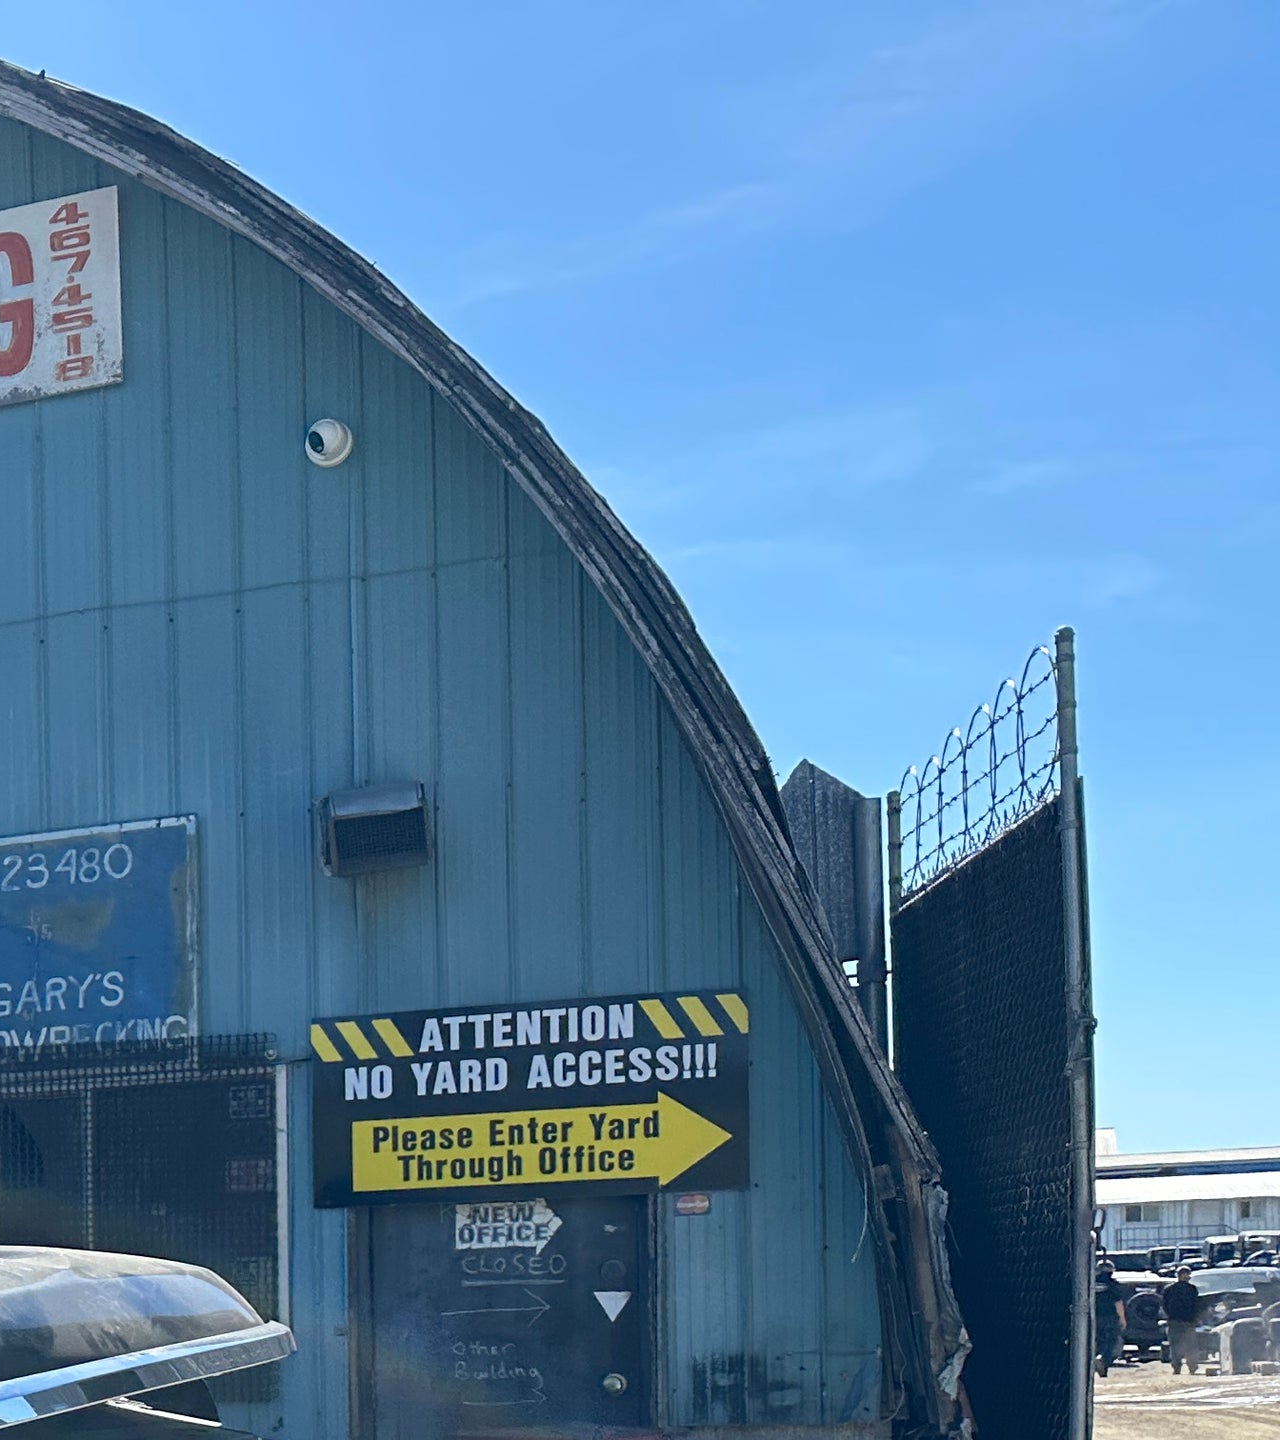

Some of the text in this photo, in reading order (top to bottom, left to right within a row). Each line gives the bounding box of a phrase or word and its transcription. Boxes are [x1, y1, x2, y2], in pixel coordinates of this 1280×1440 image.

[0, 843, 134, 892] 23480
[418, 1003, 635, 1053] ATTENTION
[344, 1043, 718, 1101] NO YARD ACCESS!!!
[372, 1111, 661, 1153] Please Enter Yard
[397, 1146, 635, 1183] Through Office
[458, 1223, 551, 1244] OFFICE
[470, 1204, 534, 1224] NEW
[461, 1254, 567, 1275] CLOSED
